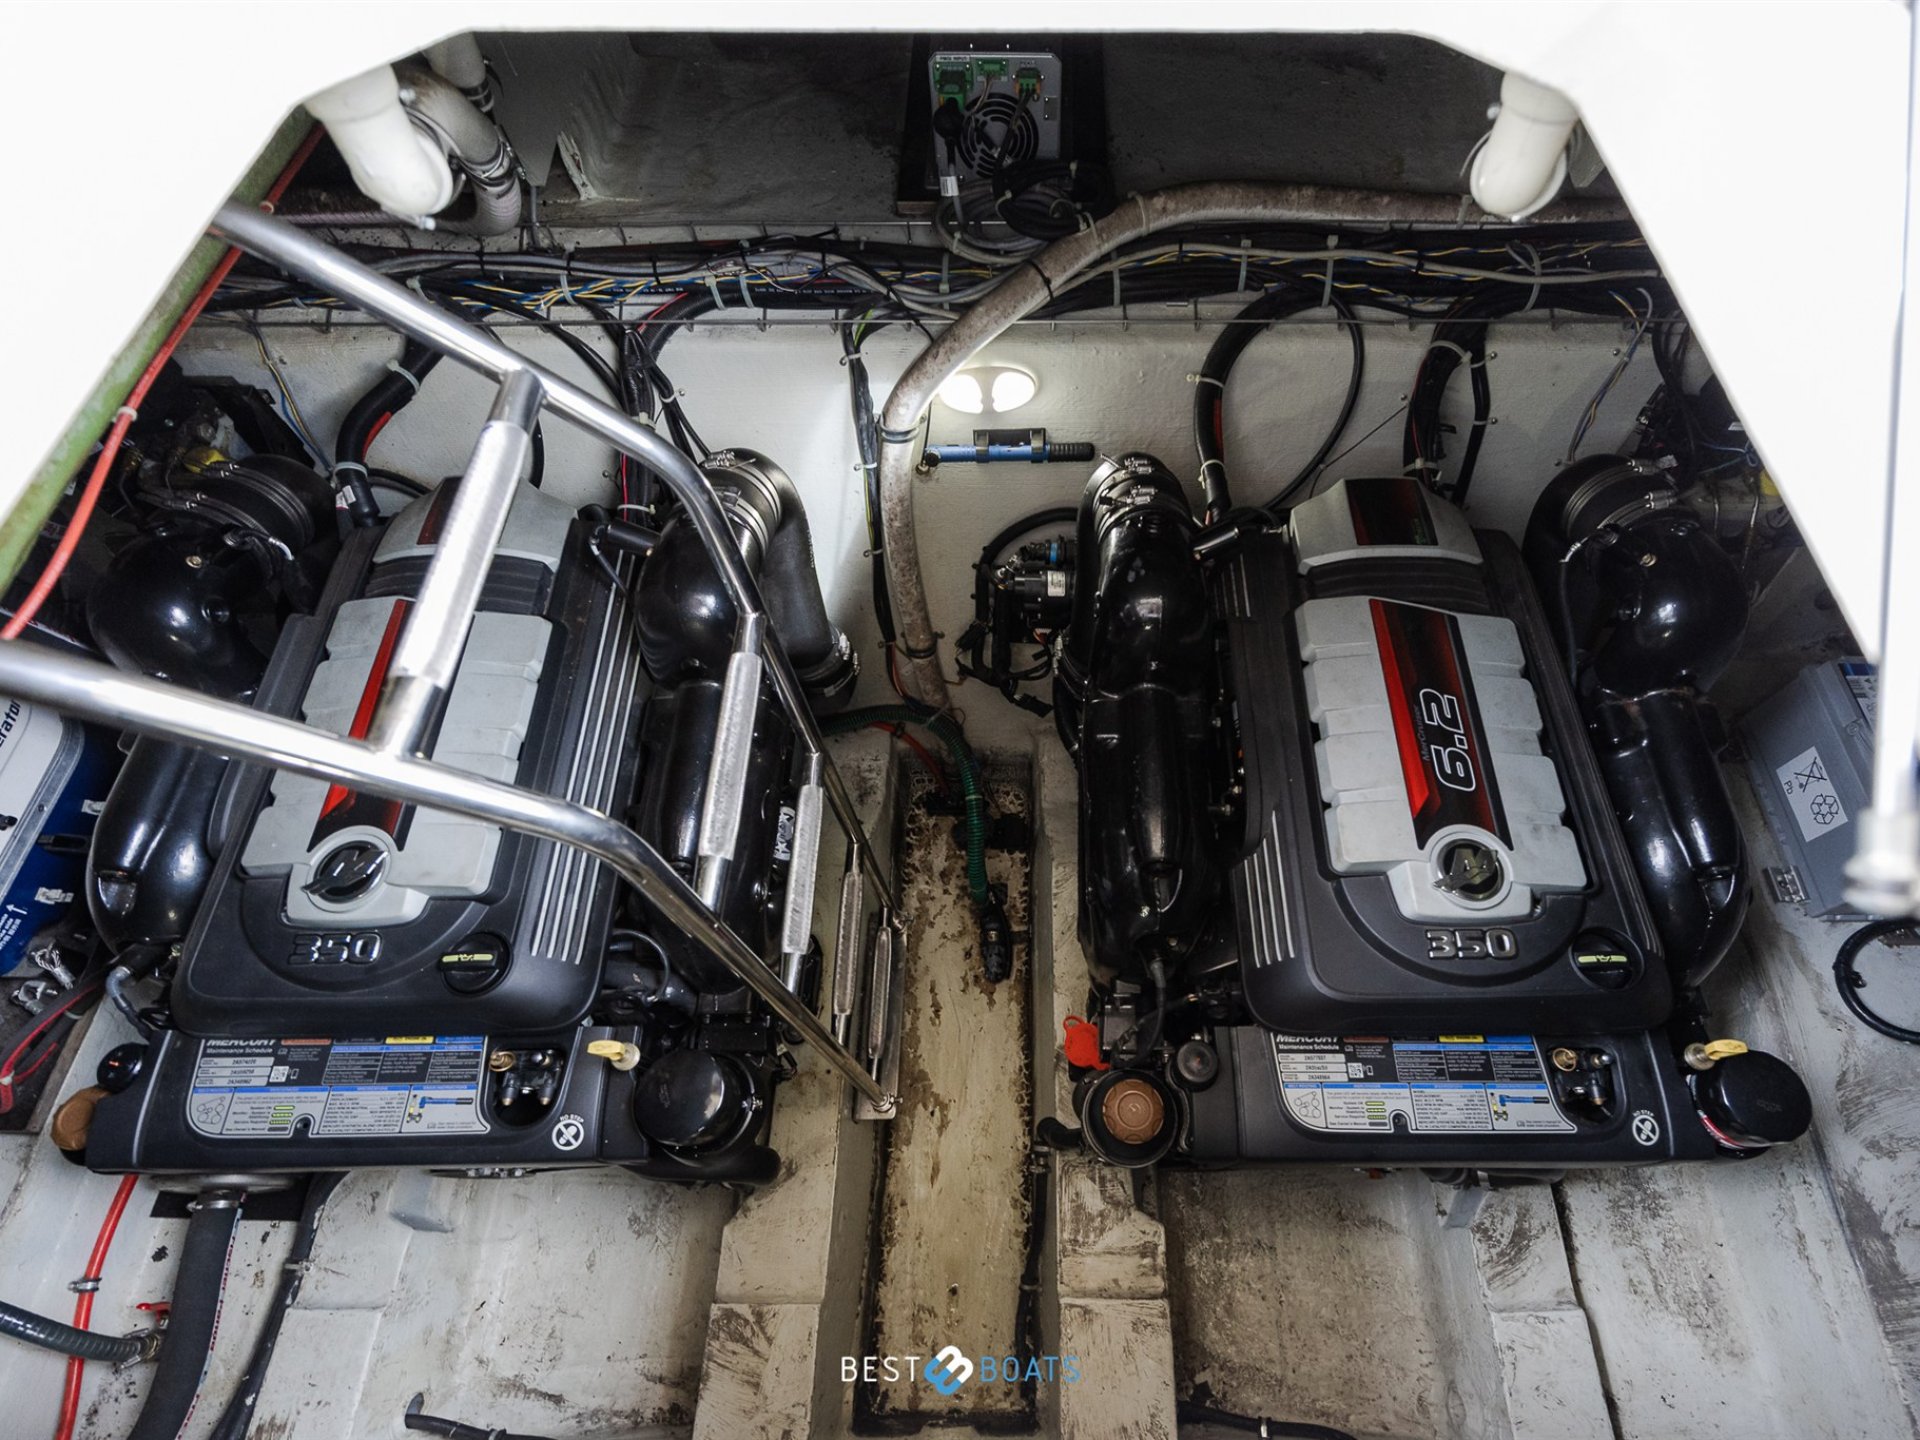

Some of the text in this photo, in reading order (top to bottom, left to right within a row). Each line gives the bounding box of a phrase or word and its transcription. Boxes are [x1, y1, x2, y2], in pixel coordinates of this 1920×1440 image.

[1419, 688, 1476, 792] 6.2
[1784, 780, 1794, 795] Pb
[287, 932, 382, 965] 350
[1425, 928, 1518, 960] 350
[559, 1113, 584, 1123] NO STEP
